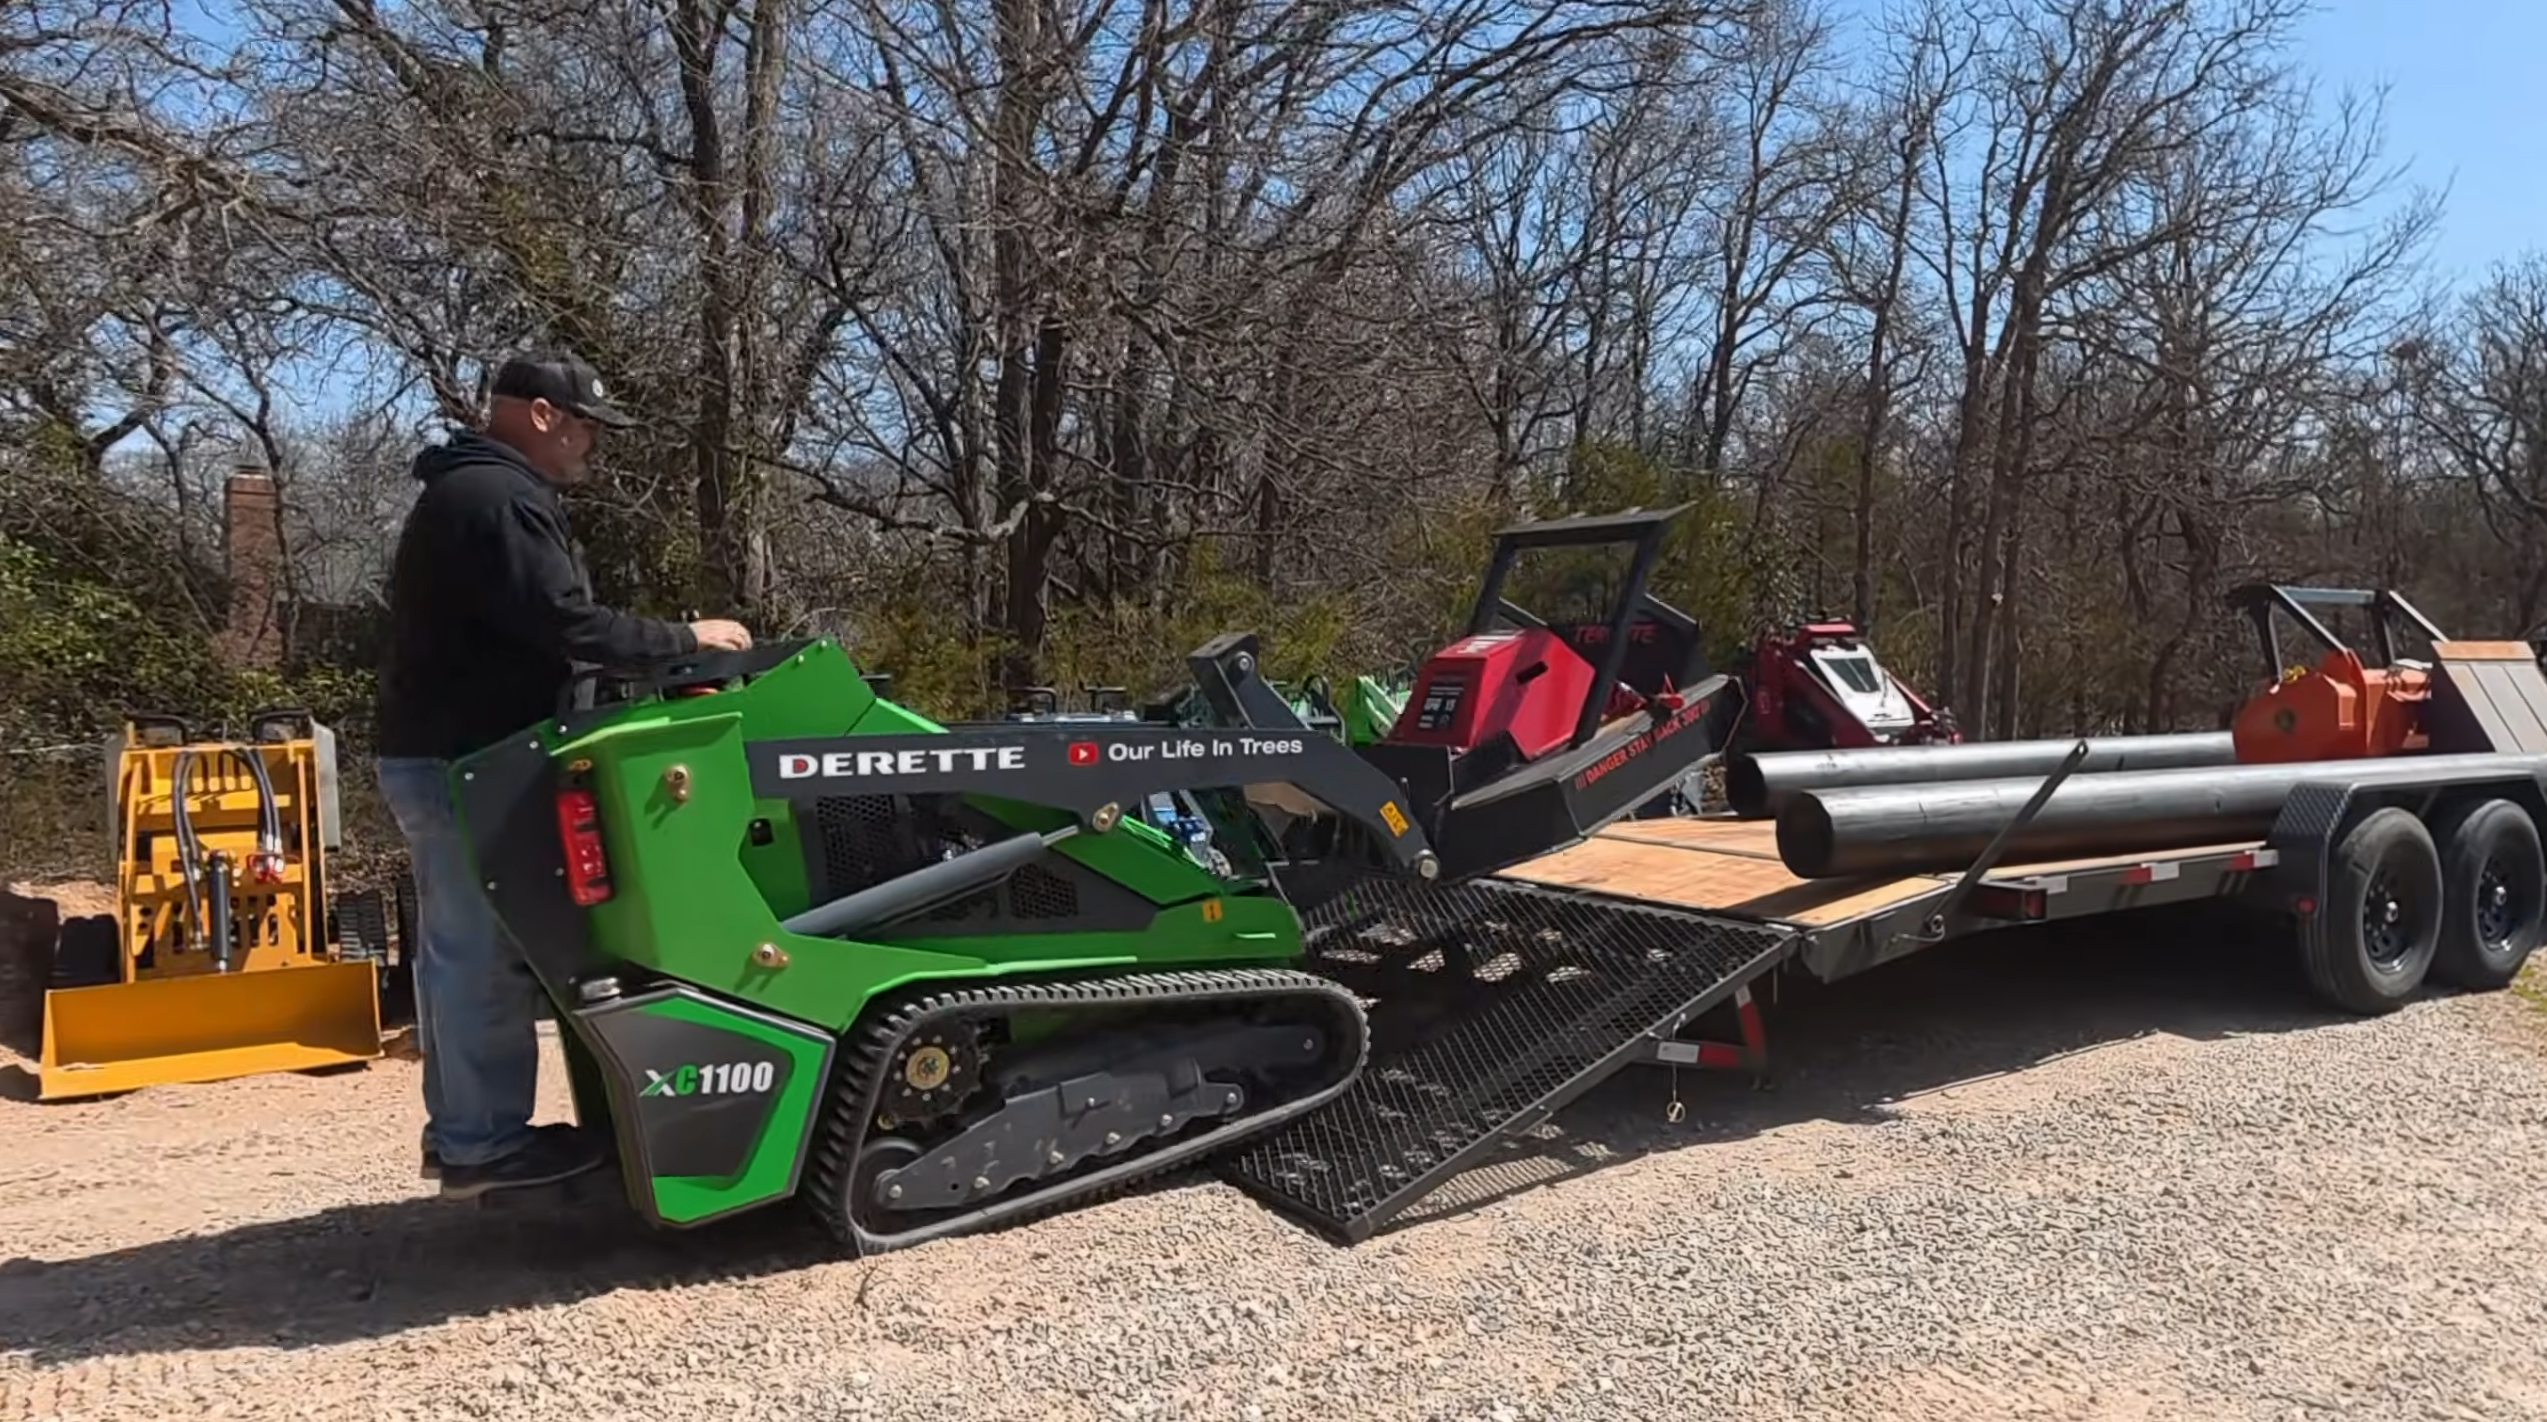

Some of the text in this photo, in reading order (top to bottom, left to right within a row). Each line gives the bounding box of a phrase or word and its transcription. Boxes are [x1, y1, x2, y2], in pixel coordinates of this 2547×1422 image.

[779, 746, 1026, 779] DERETTE
[1108, 738, 1303, 761] Our Life In Trees
[1585, 749, 1629, 785] DANGER
